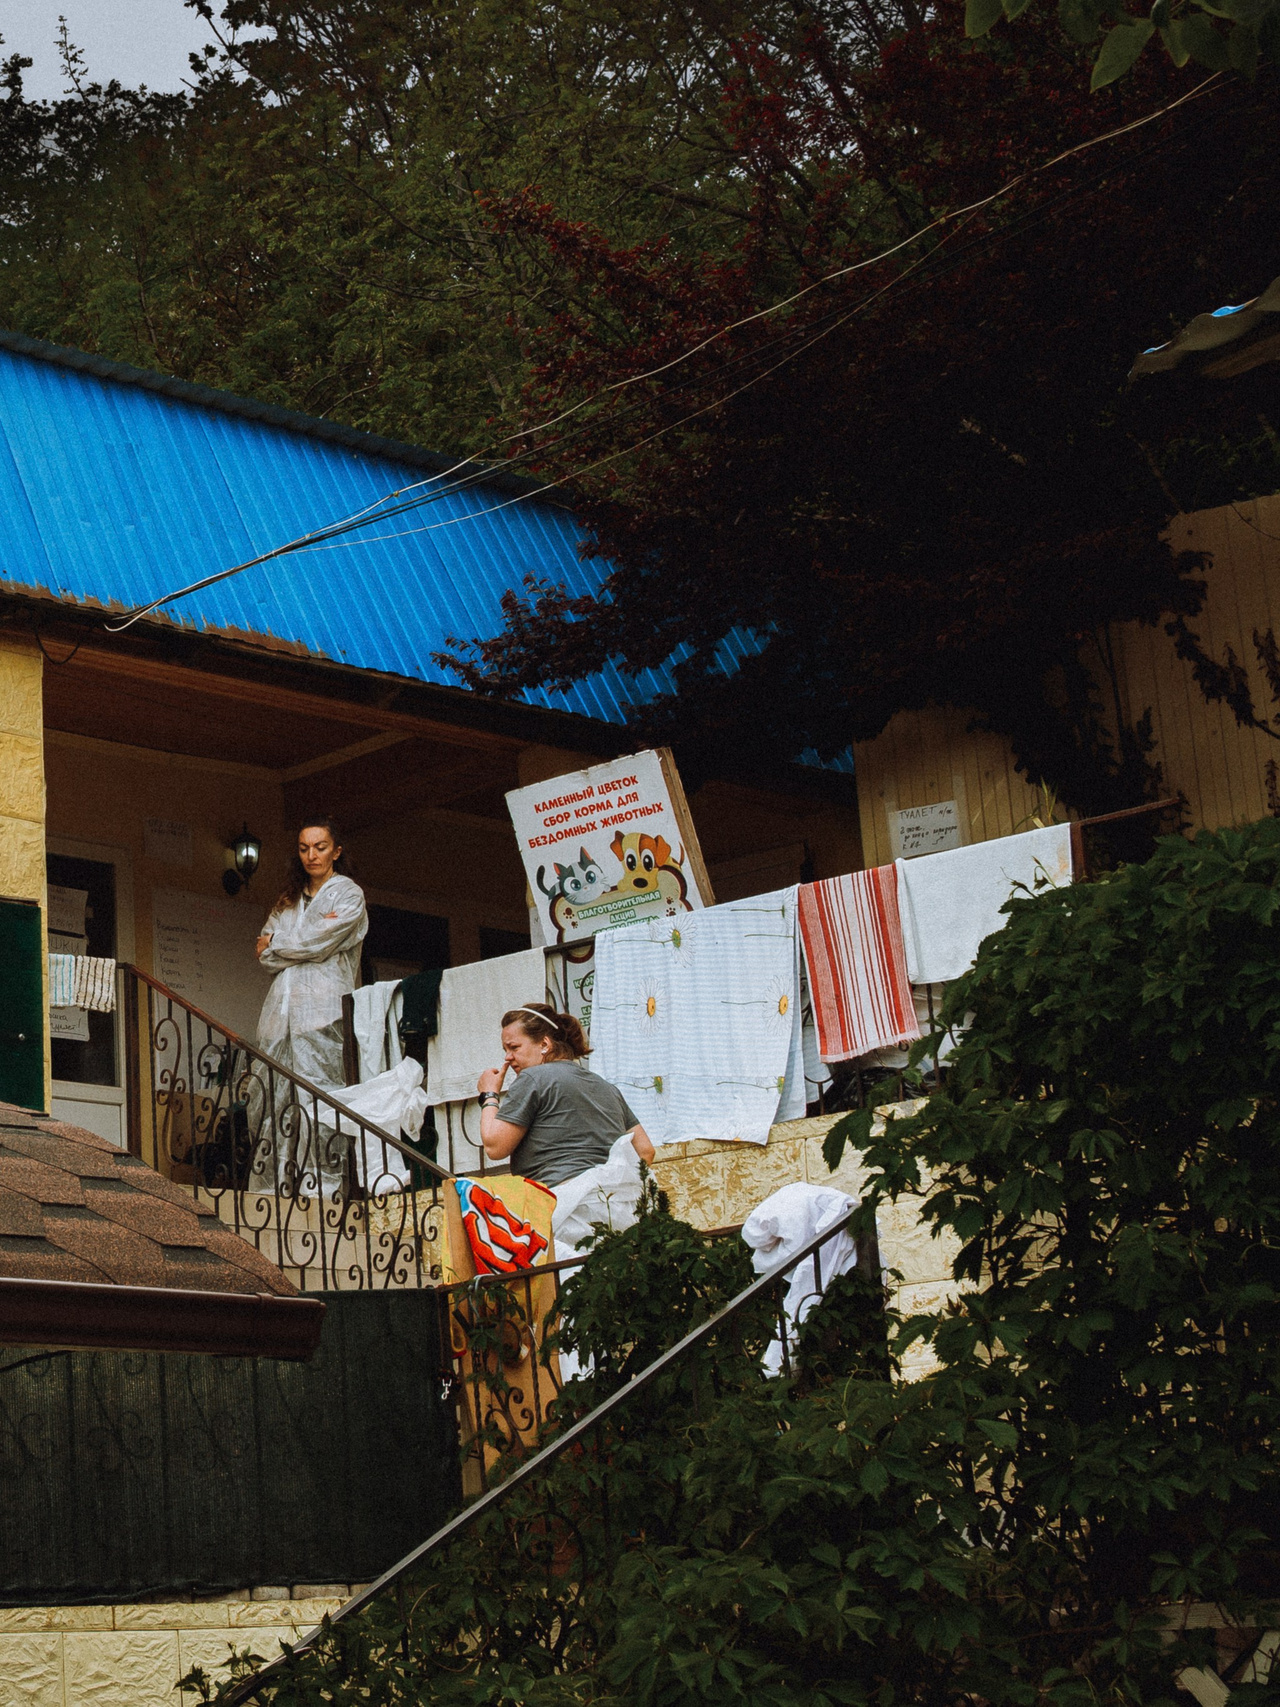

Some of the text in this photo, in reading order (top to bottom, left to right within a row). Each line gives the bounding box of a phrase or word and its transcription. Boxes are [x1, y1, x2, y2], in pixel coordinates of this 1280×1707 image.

[534, 775, 639, 814] КАМЕННЫЙ ЦВЕТОК
[543, 791, 639, 828] СБОР КОРМА ДЛЯ
[528, 802, 664, 849] БЕЗДОМНЫХ ЖИВОТНЫХ
[899, 806, 937, 819] ТУАЛЕТ
[577, 890, 661, 920] БЛАГОТВОРИТЕЛЬНАЯ
[610, 908, 636, 924] АКЦИЯ
[49, 937, 81, 955] ШКИ
